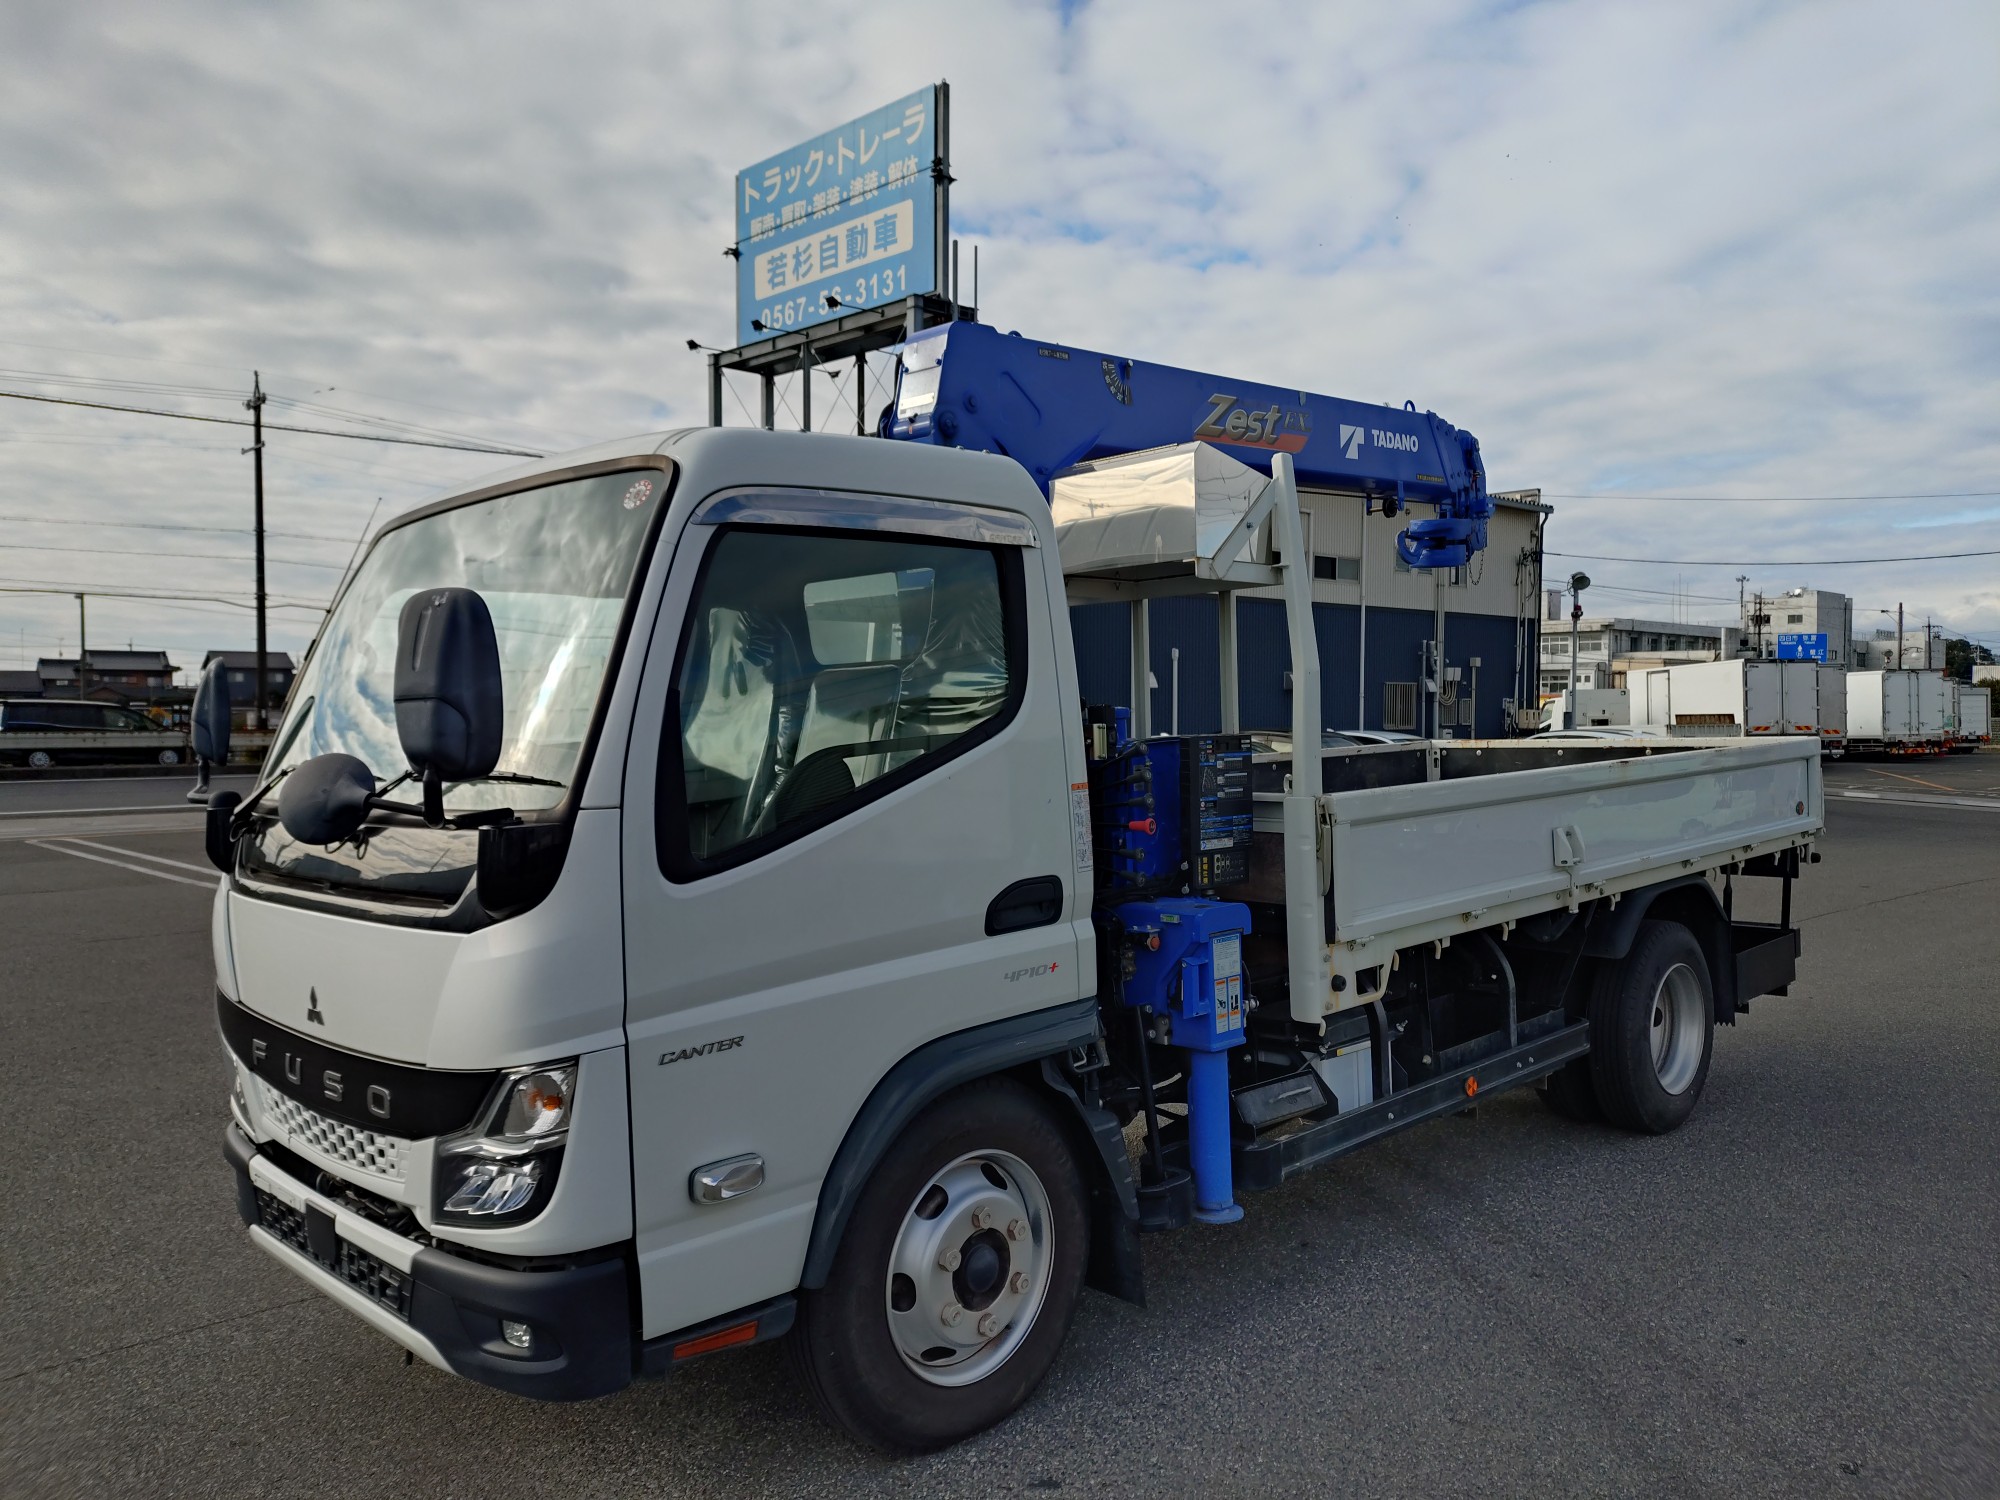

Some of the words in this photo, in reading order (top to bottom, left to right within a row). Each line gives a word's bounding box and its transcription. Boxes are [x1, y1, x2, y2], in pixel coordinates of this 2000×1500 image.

[744, 103, 925, 214] トラック・トレーラ
[767, 212, 898, 291] 若杉自動車
[1194, 393, 1282, 445] Zest
[1371, 429, 1419, 453] TADANO
[252, 1038, 391, 1119] FUSO
[658, 1035, 745, 1066] CANTER
